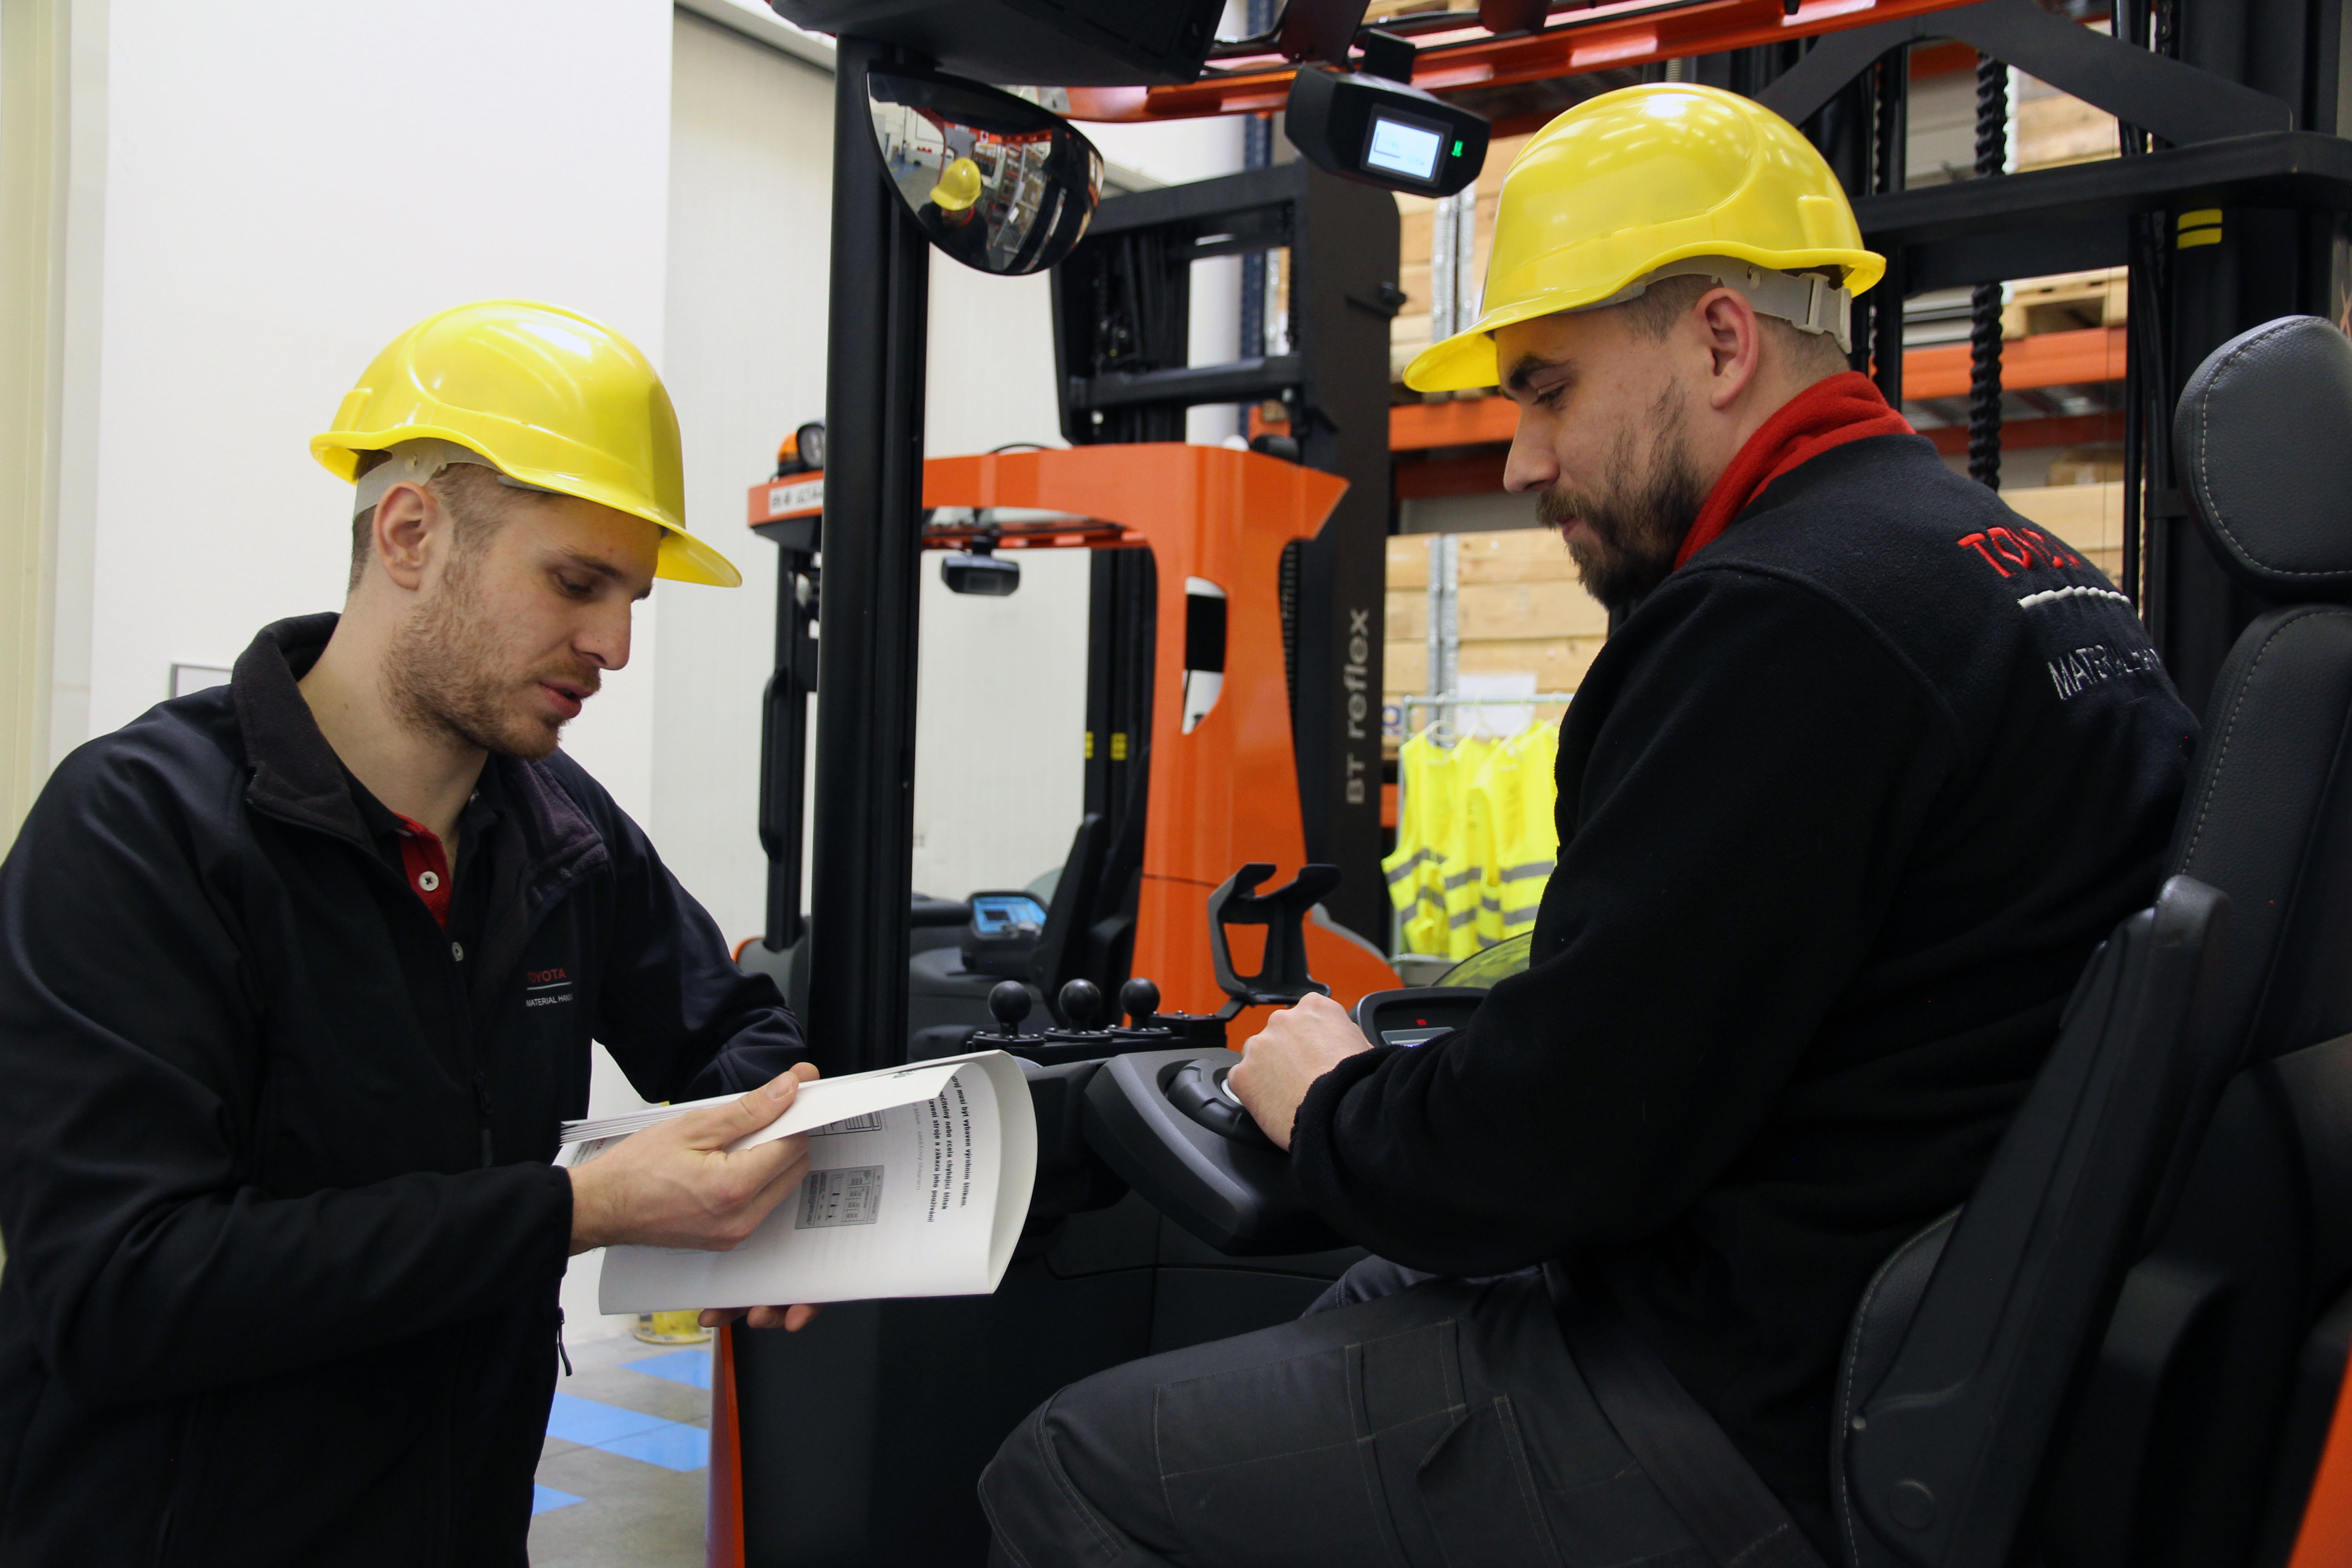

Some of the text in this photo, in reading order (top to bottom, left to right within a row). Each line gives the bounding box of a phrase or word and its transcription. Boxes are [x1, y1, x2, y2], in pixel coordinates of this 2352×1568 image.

[1344, 608, 1369, 804] BT reflex
[527, 968, 567, 983] TOYOTA
[526, 996, 558, 1007] MATERIAL
[961, 1107, 970, 1117] být
[933, 1120, 941, 1139] stroje
[963, 1119, 971, 1147] vybaven
[964, 1149, 972, 1180] výrobním
